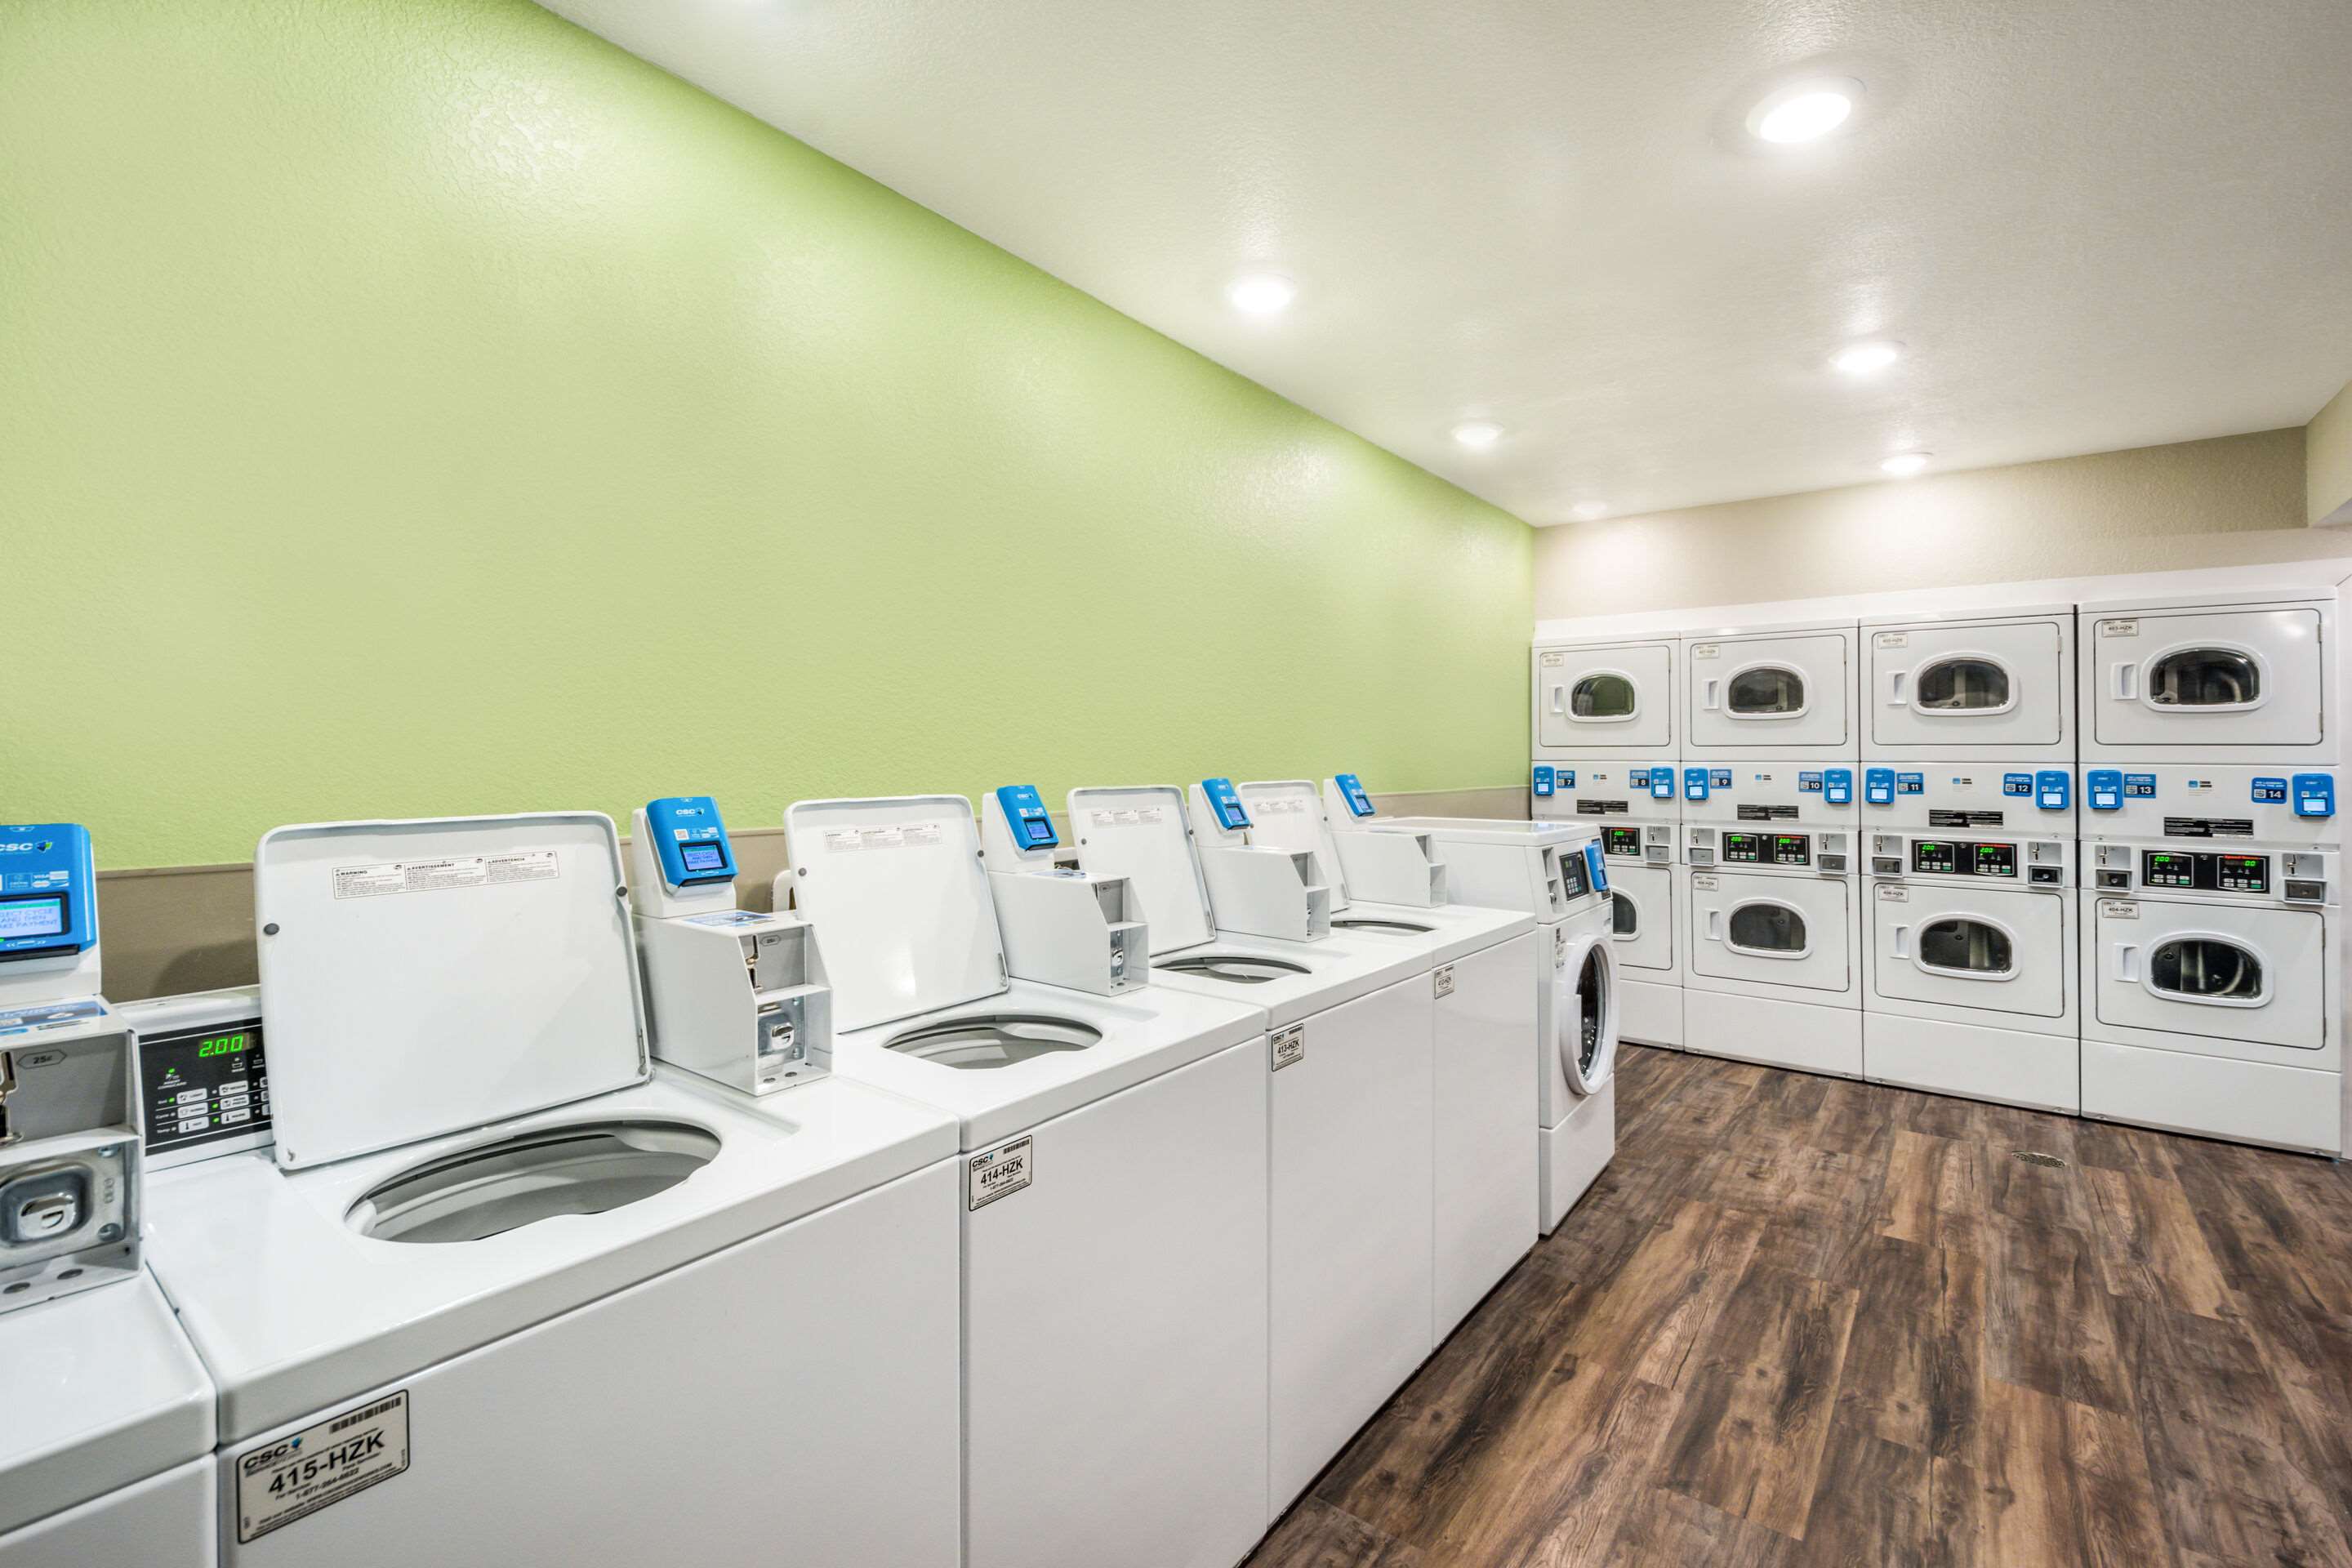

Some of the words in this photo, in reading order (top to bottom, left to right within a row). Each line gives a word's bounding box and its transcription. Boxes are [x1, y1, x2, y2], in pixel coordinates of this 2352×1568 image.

[198, 1034, 244, 1058] 2.00
[1277, 1038, 1299, 1054] 413-HZK
[972, 1156, 989, 1167] CSC
[981, 1158, 1023, 1184] 414-HZK
[245, 1444, 288, 1469] CSC
[268, 1430, 385, 1493] 415-HZK
